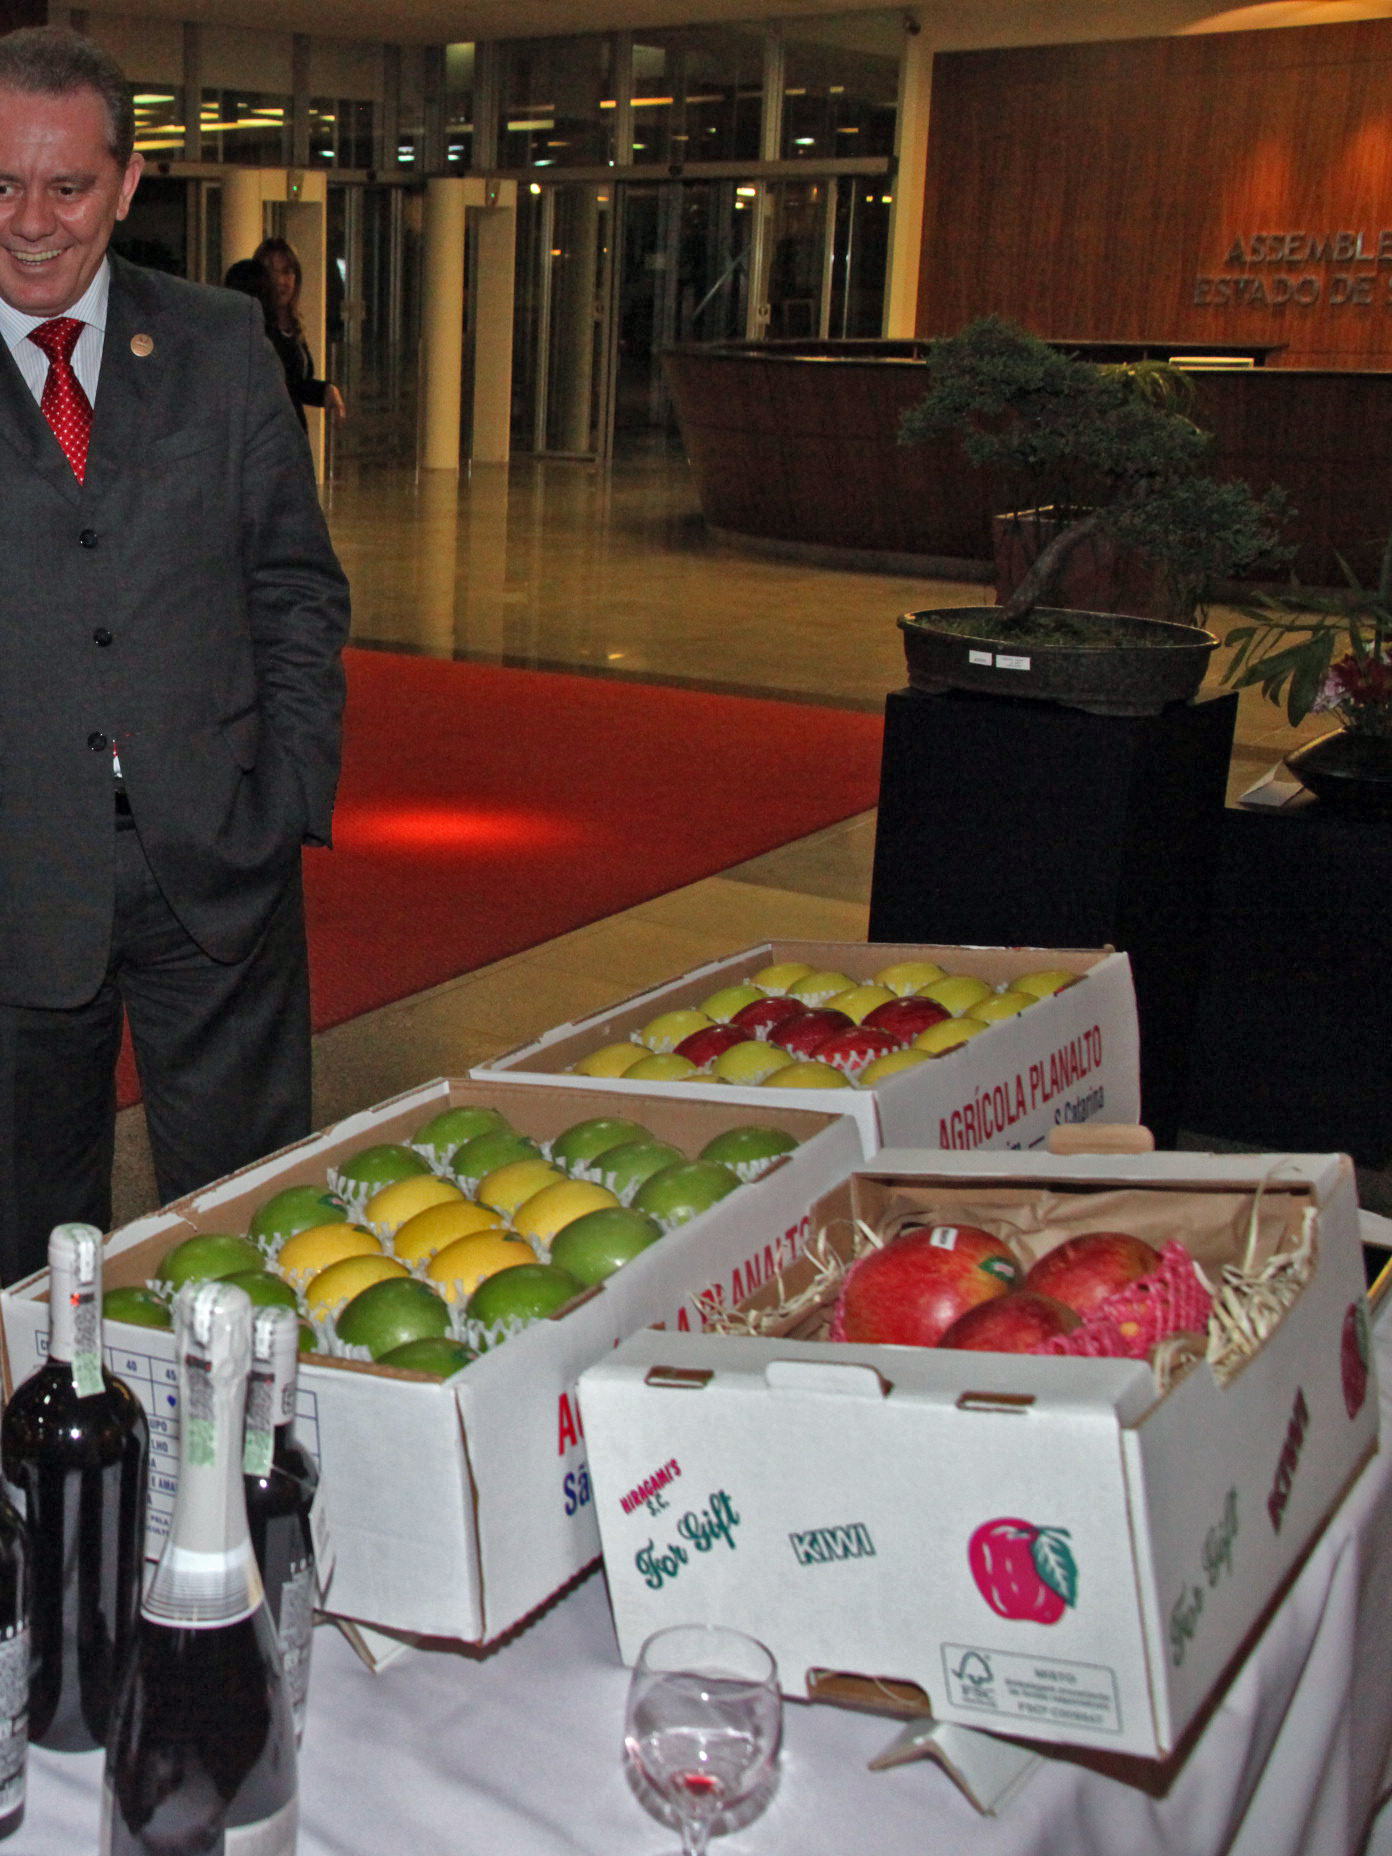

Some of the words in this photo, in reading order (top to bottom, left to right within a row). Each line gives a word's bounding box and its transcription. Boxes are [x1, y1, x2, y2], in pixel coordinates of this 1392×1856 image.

[1194, 273, 1321, 306] ESTADO
[1329, 272, 1377, 305] DE
[939, 1074, 1027, 1150] AGRÍCOLA
[1029, 1025, 1103, 1110] PLANALTO
[126, 1359, 138, 1373] 40
[166, 1367, 178, 1382] 45
[619, 1458, 682, 1515] HIRAGAMI'S
[635, 1537, 689, 1590] For
[677, 1489, 740, 1552] Gift
[788, 1522, 877, 1566] KIWI
